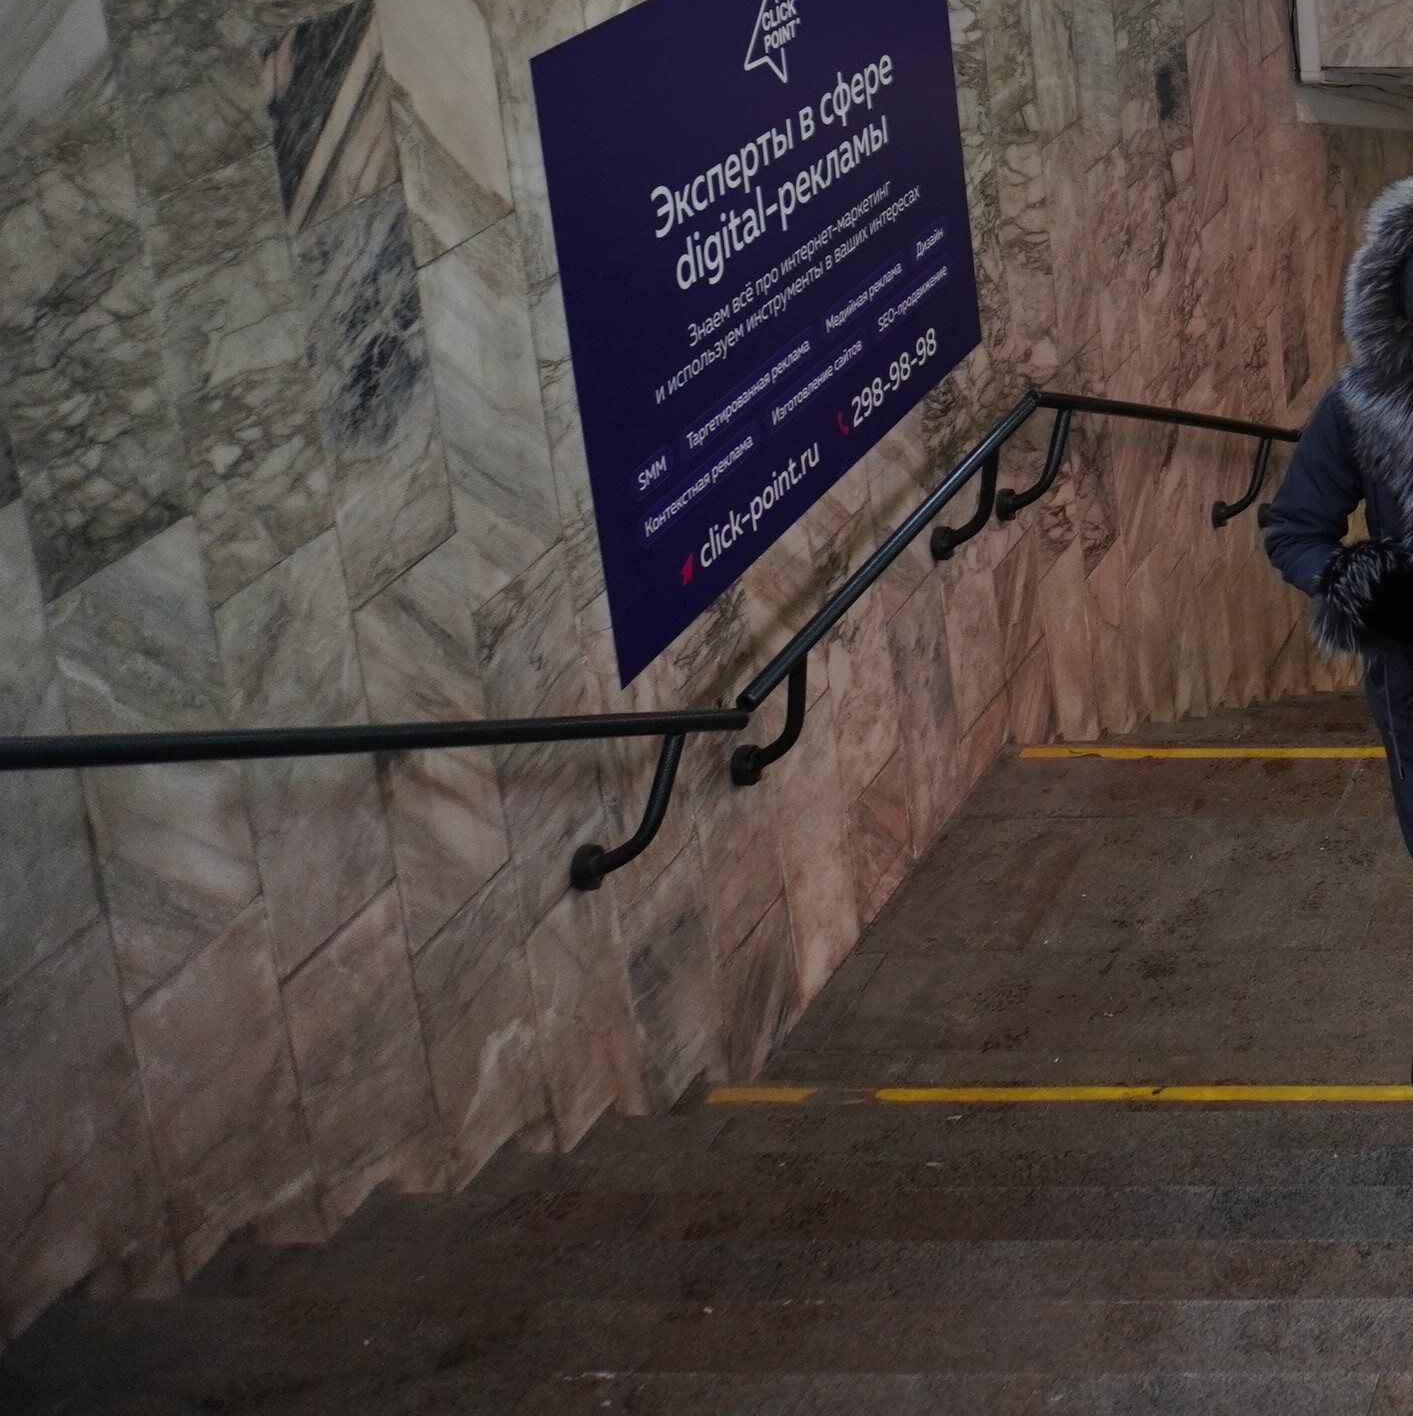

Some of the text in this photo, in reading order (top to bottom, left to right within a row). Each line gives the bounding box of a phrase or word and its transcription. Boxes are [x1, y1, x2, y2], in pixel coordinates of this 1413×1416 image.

[764, 19, 799, 54] POINT
[651, 54, 893, 238] Эксперты в сфере
[676, 114, 888, 290] digital-рекламы
[915, 227, 944, 261] Дизайн
[655, 185, 920, 405] и используем инструменты в ваших интересах
[687, 180, 891, 347] Знаем всё про интернет-маркетинг
[825, 262, 902, 333] Медийная реклама
[877, 265, 948, 333] SEO-продвижение
[686, 340, 811, 450] Таргетированная реклама
[771, 339, 863, 426] Изготовление сайтов
[851, 327, 938, 428] 298-98-98
[637, 455, 667, 491] SMM
[644, 435, 754, 538] Контекстная реклама
[700, 442, 820, 569] click-point.ru
